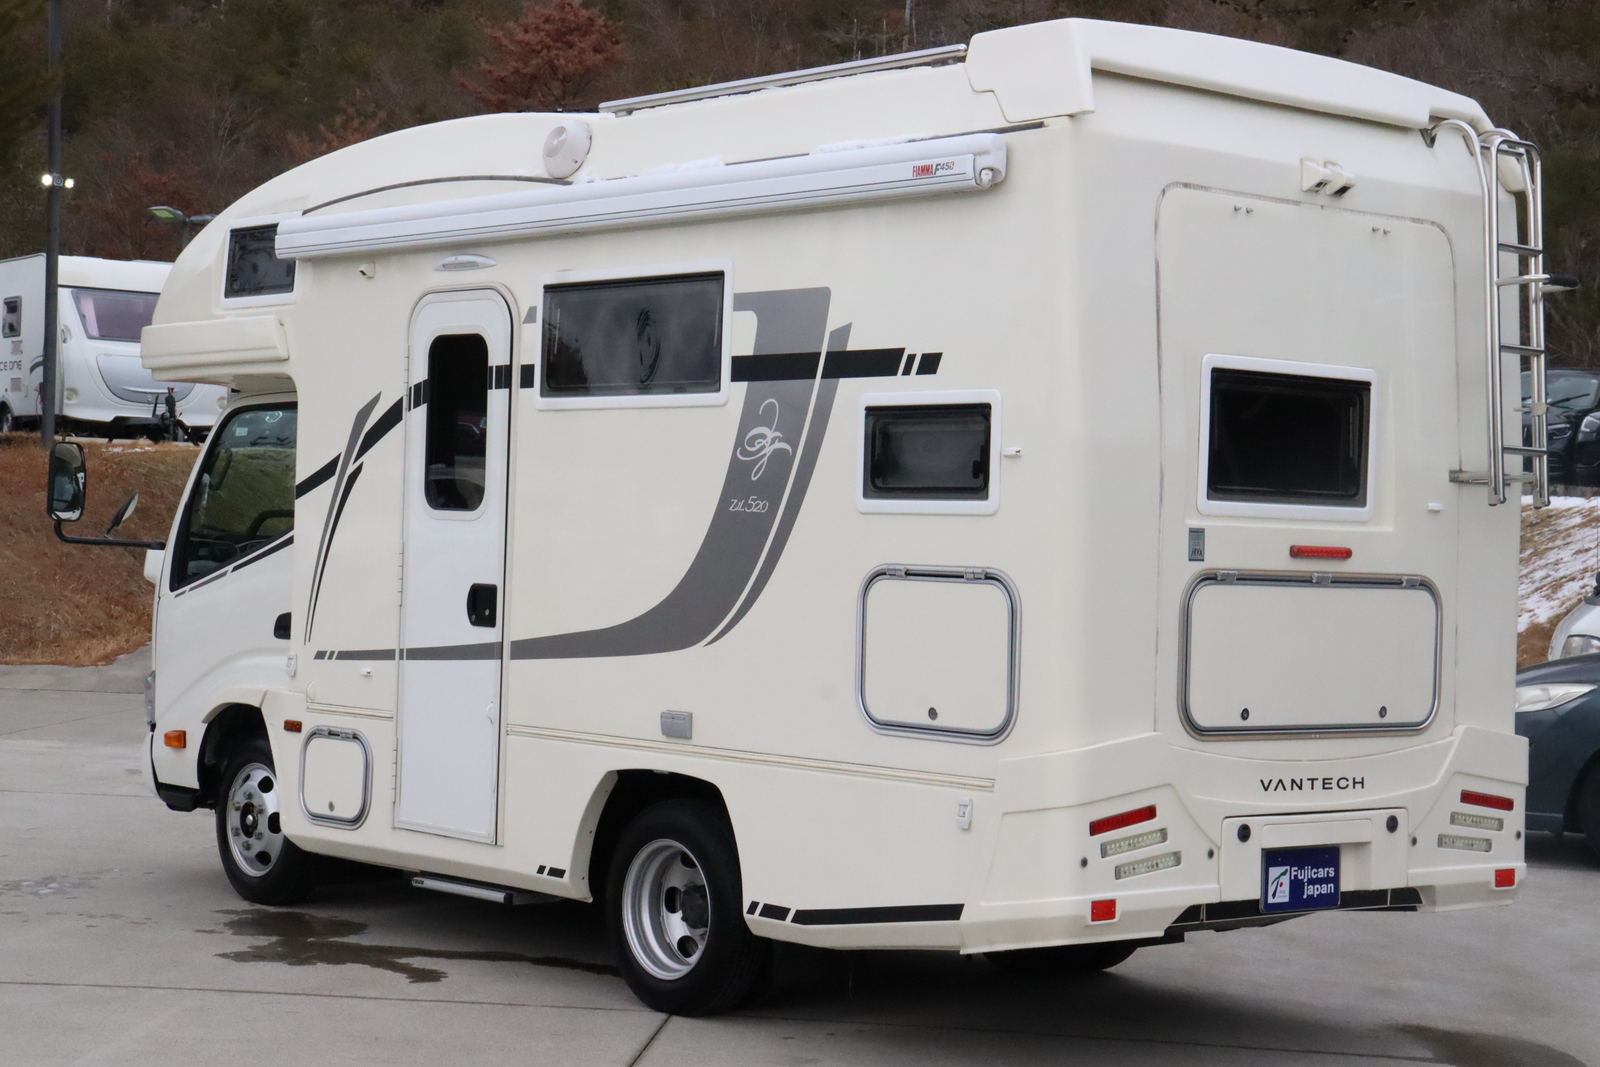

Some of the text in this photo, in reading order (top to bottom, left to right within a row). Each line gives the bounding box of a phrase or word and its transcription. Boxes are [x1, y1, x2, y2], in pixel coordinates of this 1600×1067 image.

[912, 164, 934, 178] FIAMMA
[744, 495, 769, 513] 520
[1259, 776, 1365, 792] VANTECH
[1290, 866, 1335, 882] Fujicars
[1302, 882, 1335, 899] japan
